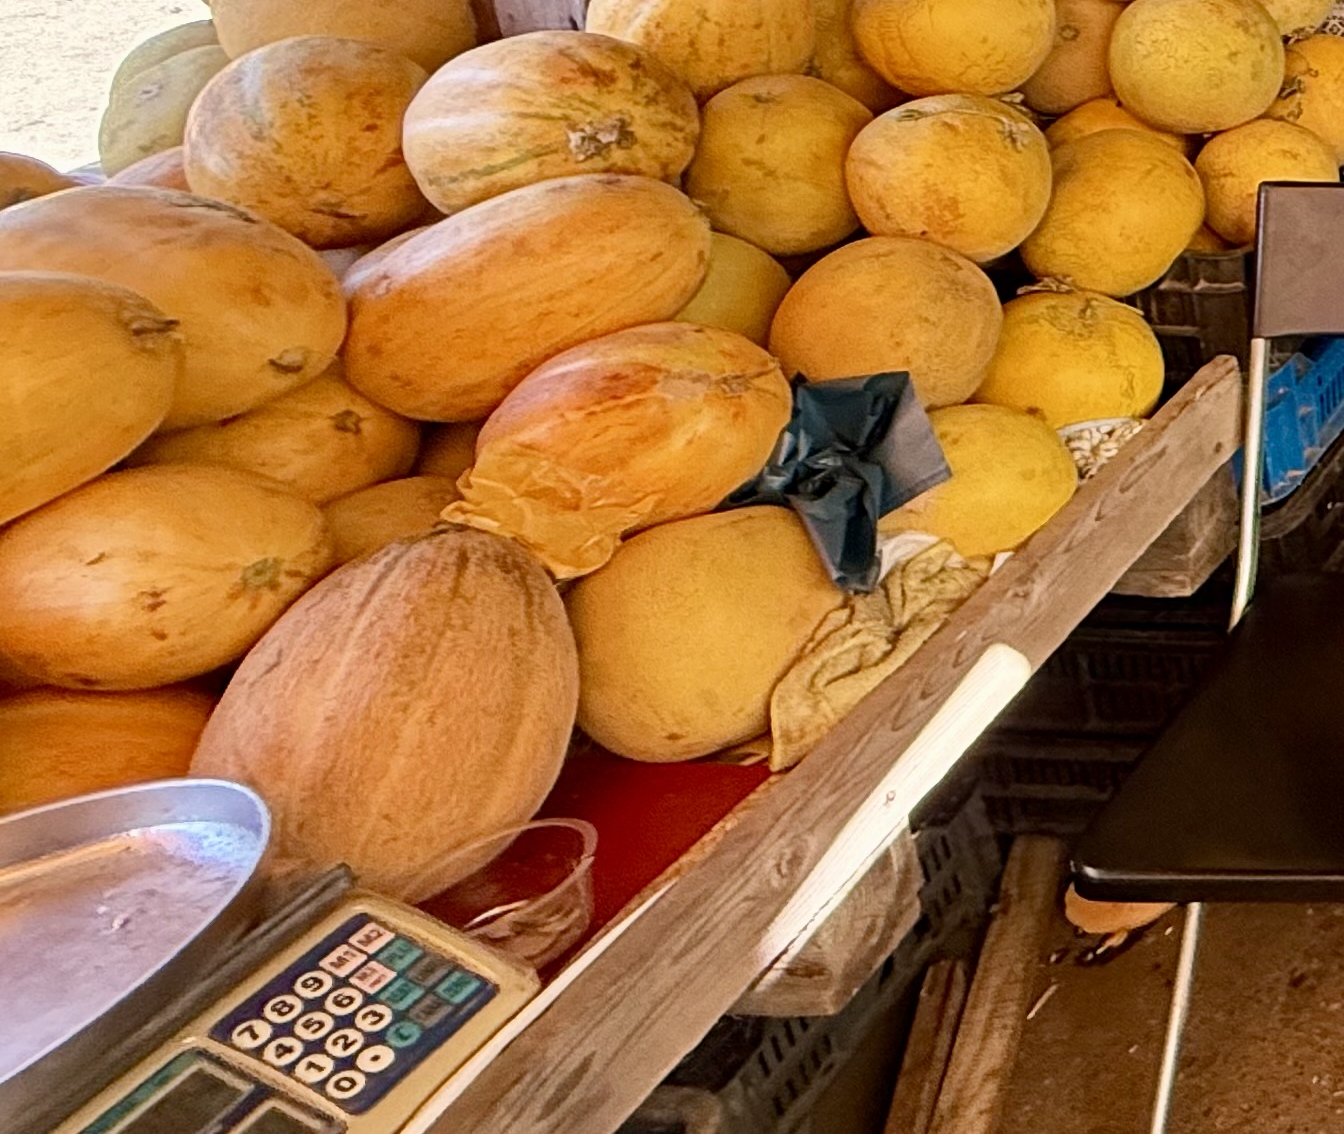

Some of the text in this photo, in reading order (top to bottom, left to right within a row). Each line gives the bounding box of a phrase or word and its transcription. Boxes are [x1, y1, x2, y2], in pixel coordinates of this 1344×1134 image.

[301, 974, 324, 993] 9
[270, 999, 295, 1017] 8
[331, 992, 355, 1009] 6
[303, 1016, 326, 1034] 5
[361, 1009, 385, 1026] 3
[238, 1023, 261, 1043] 7
[331, 1033, 358, 1051] 2
[274, 1043, 295, 1060] 4
[304, 1060, 326, 1075] 1
[333, 1075, 357, 1093] 0
